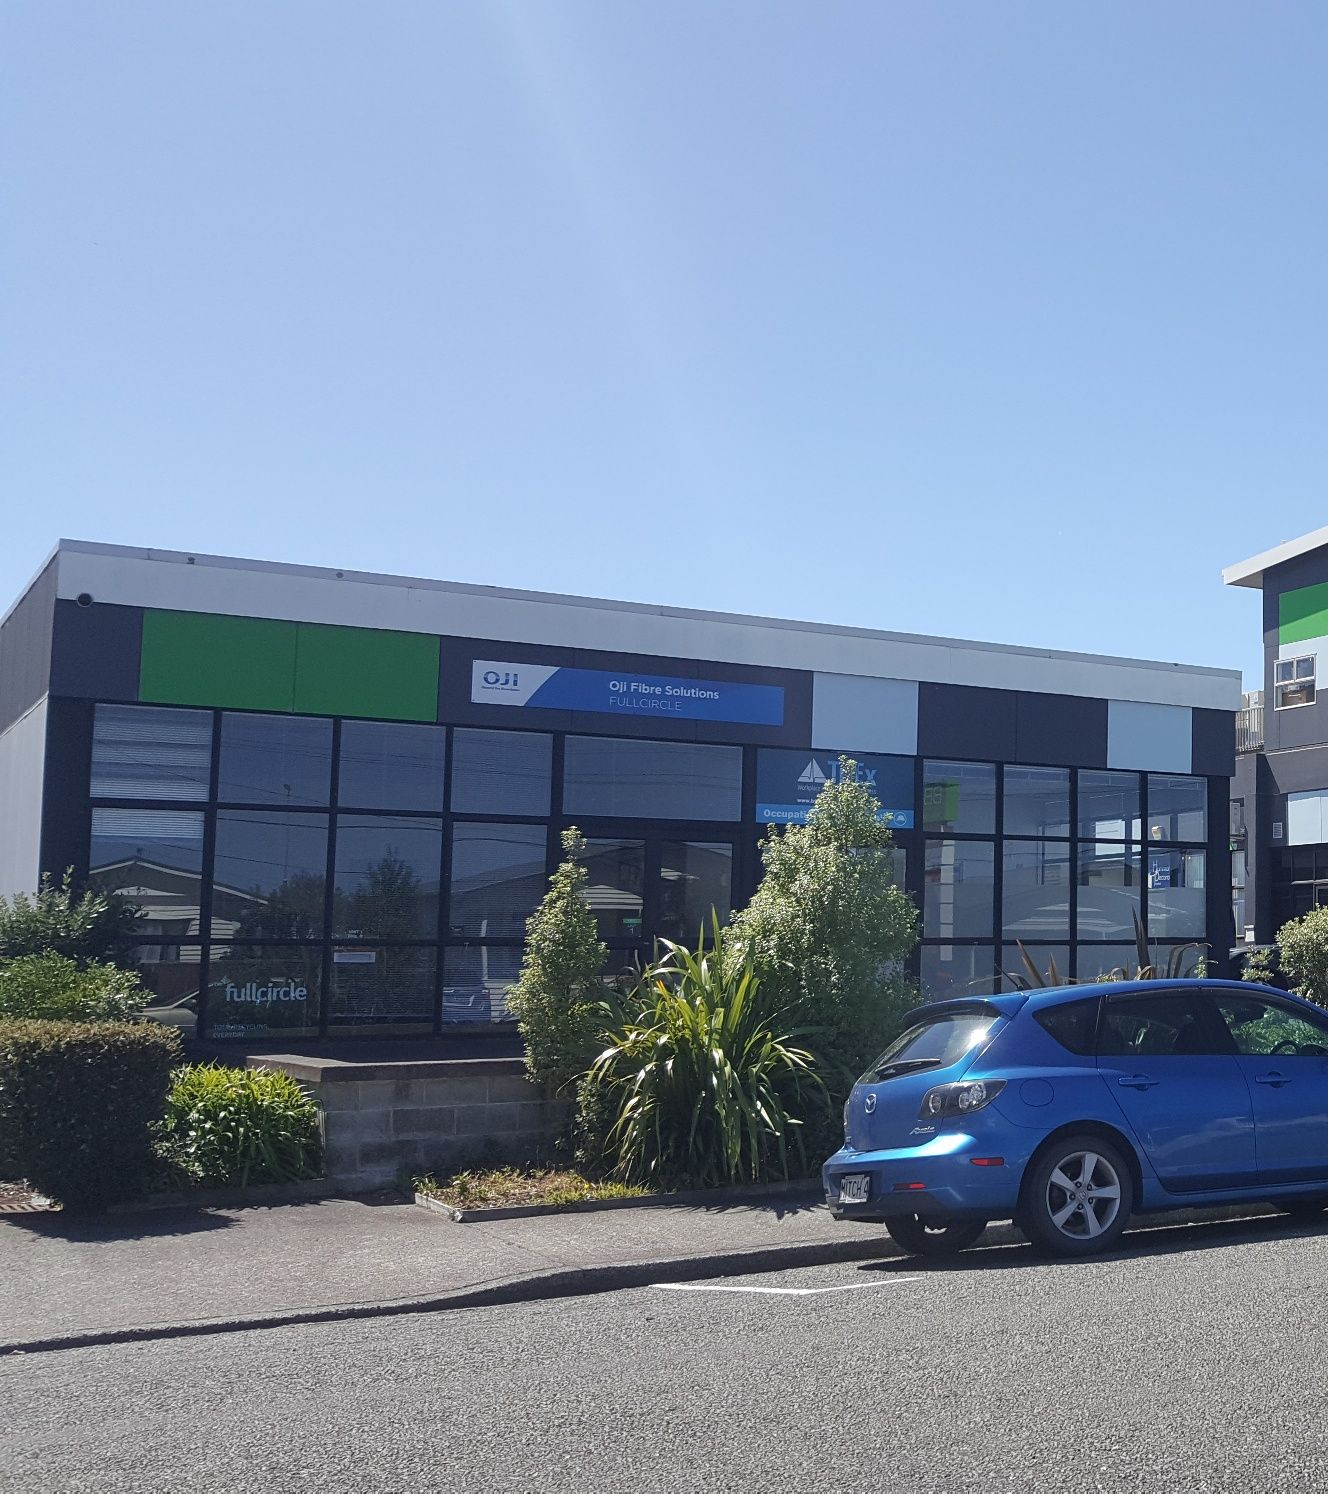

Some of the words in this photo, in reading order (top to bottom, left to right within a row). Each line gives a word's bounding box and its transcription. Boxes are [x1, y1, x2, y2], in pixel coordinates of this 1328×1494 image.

[483, 670, 519, 687] OJI
[609, 680, 627, 693] Oji
[630, 682, 662, 695] Fibre
[665, 685, 720, 700] Solutions
[609, 696, 682, 711] FULLCIRCLE
[763, 808, 808, 819] Occupati
[225, 982, 307, 1001] fullcircle
